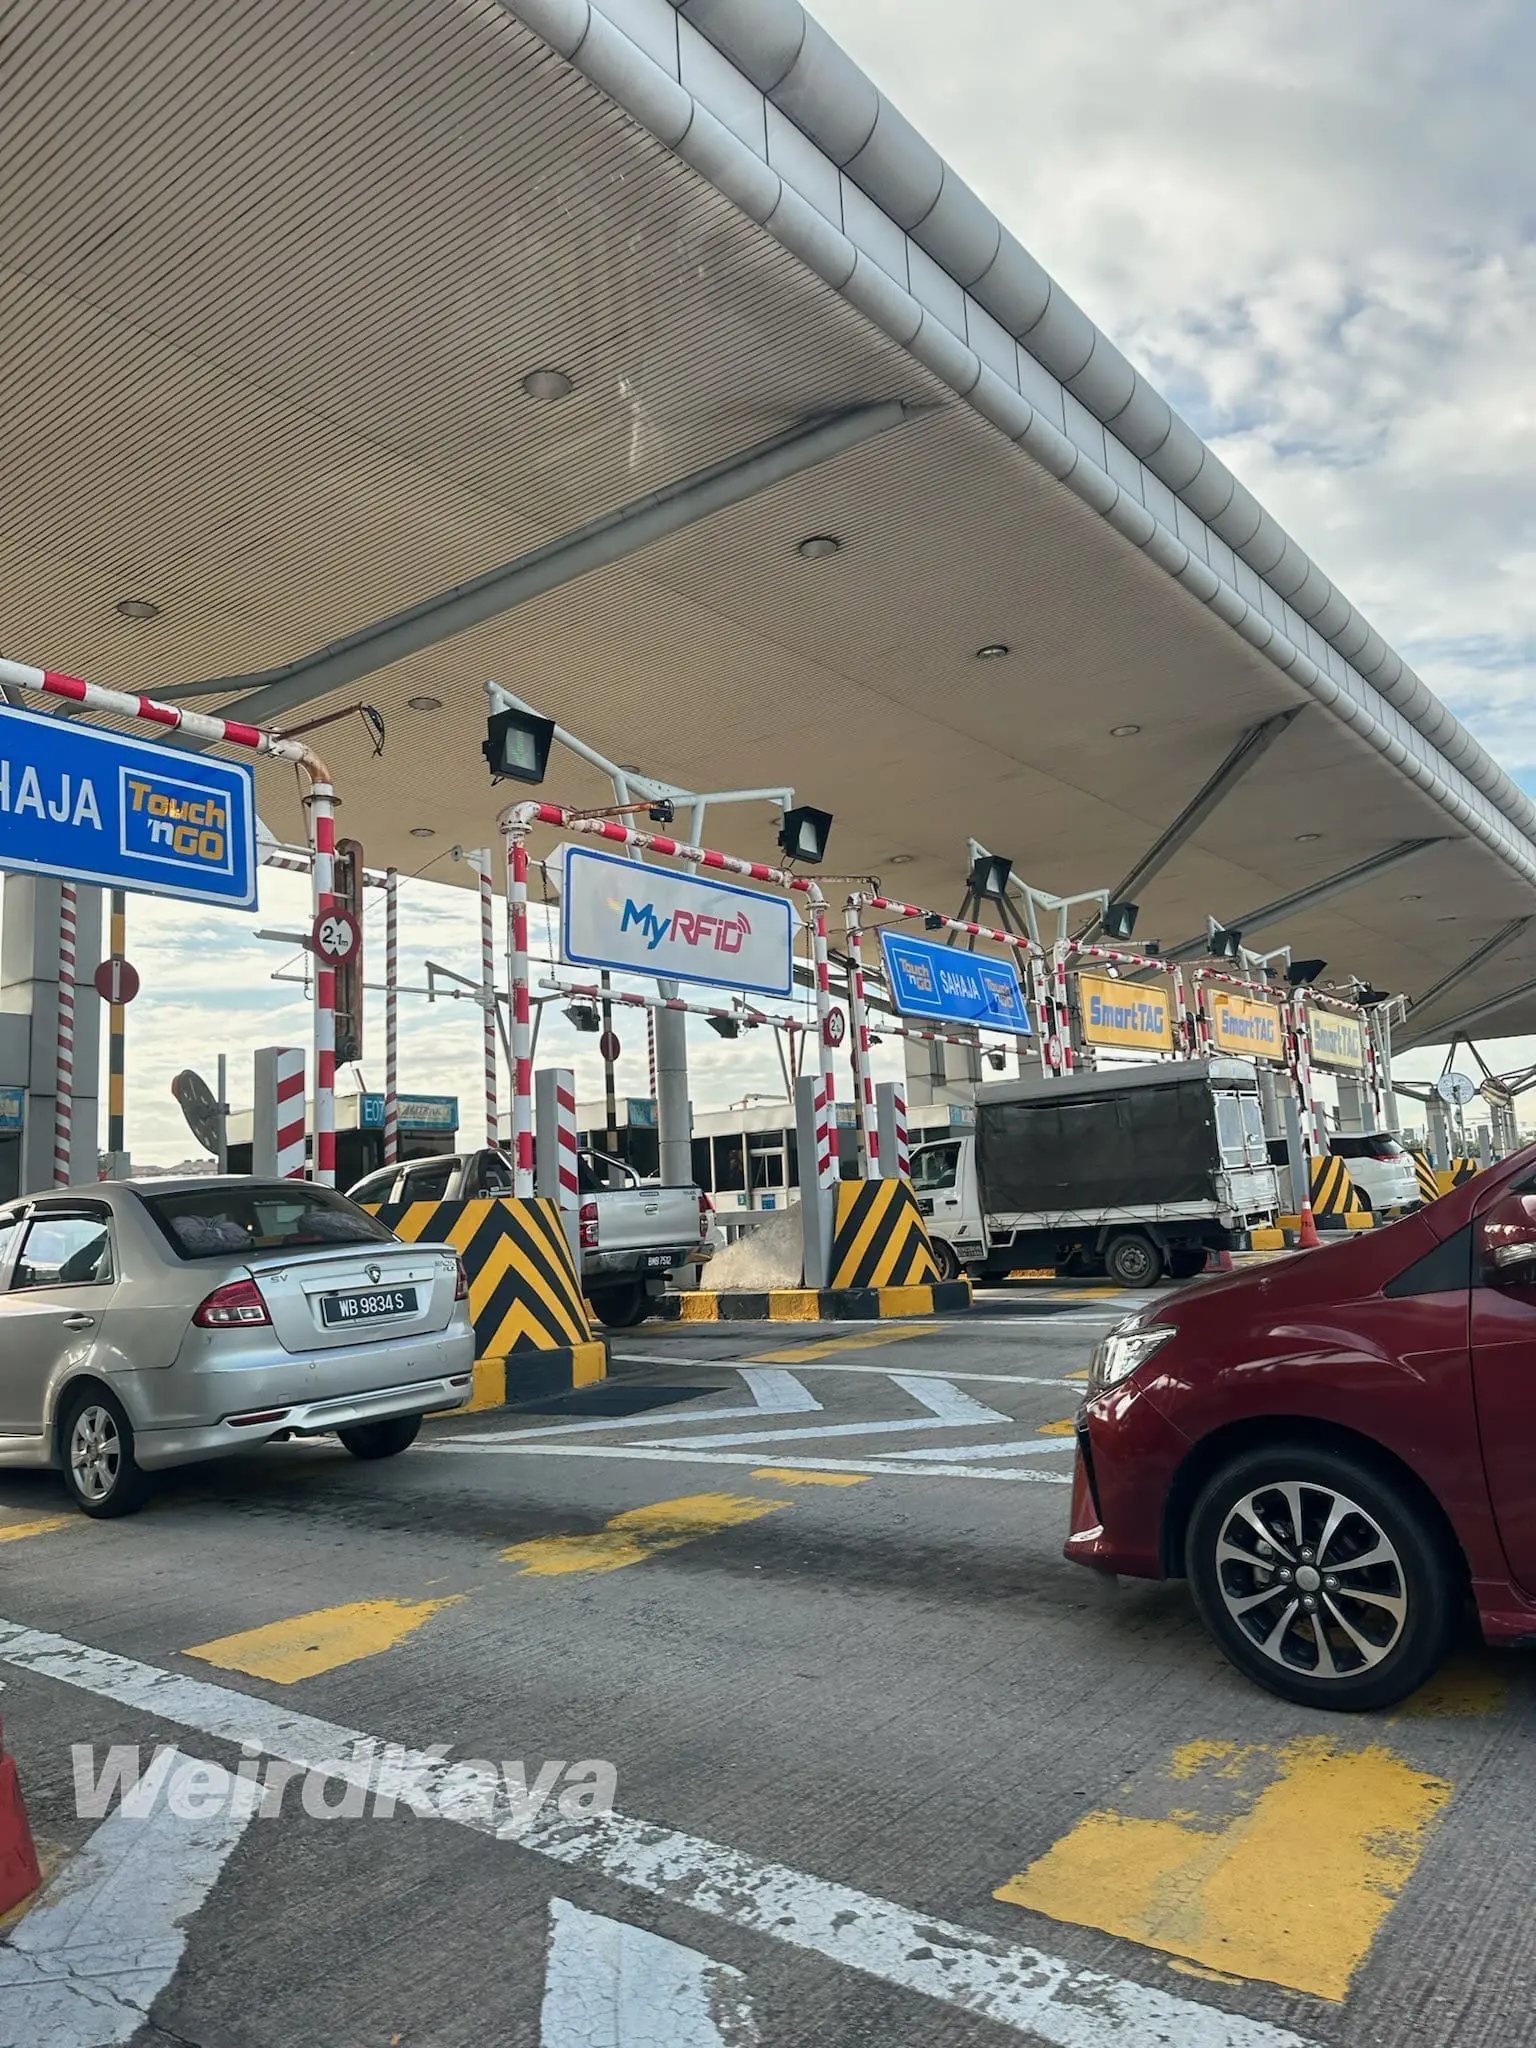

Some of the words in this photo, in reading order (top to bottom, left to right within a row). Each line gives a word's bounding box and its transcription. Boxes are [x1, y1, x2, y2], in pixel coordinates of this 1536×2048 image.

[128, 780, 226, 829] Touch
[899, 957, 929, 978] Touch
[939, 969, 981, 1000] SAHAJA
[1090, 995, 1164, 1034] SmartTAG
[1222, 1009, 1274, 1043] SmartTAG
[339, 1298, 358, 1317] WB
[360, 1294, 394, 1314] 9834
[395, 1292, 404, 1309] S
